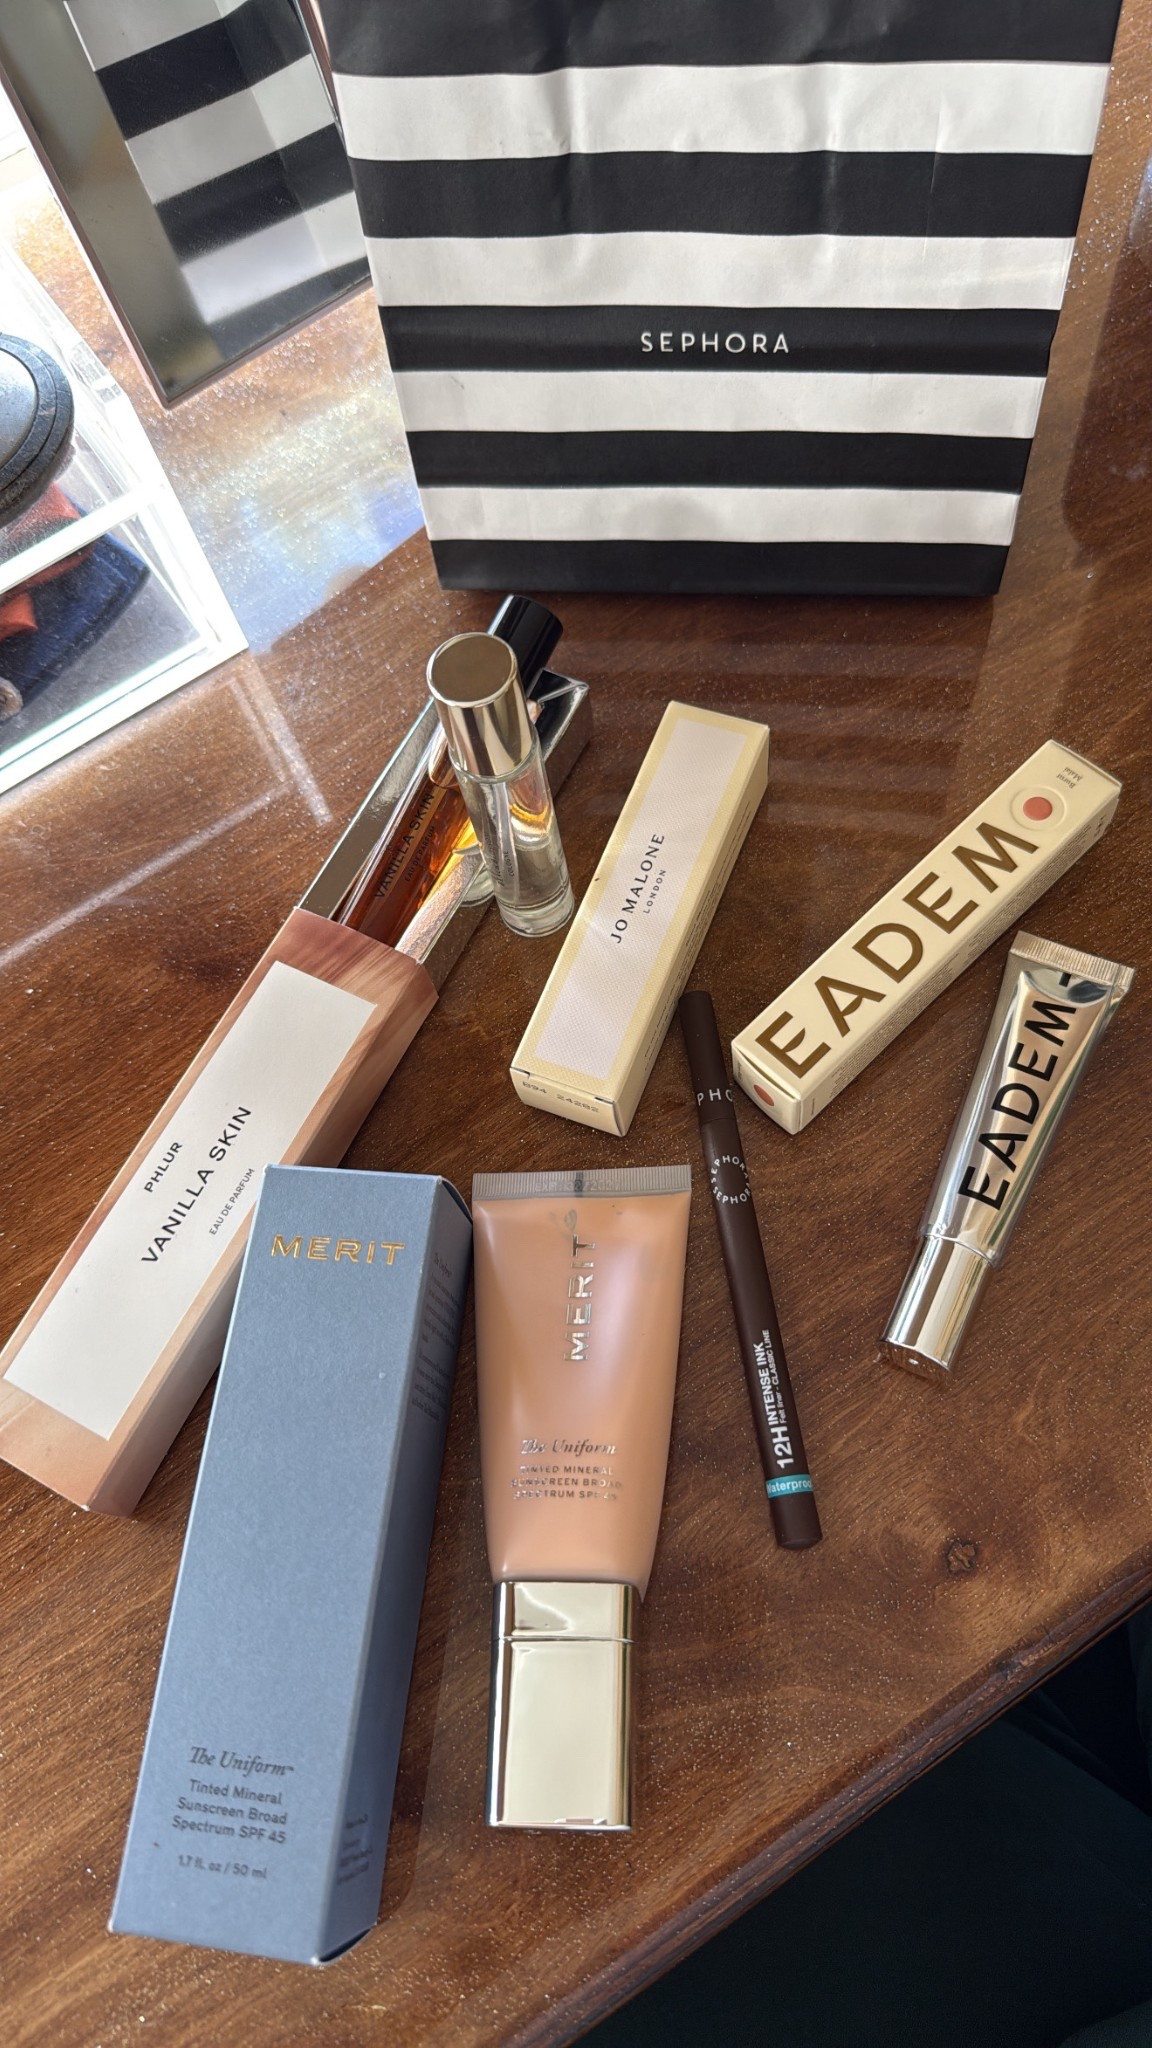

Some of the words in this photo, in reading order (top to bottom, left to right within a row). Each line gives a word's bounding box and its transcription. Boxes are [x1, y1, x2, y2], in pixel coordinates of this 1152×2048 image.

[640, 332, 790, 354] SEPHORA
[375, 835, 414, 899] VANILLA
[410, 793, 435, 831] SKIN
[610, 919, 628, 944] JO
[621, 834, 665, 914] MALONE
[643, 869, 667, 914] LONDON
[755, 821, 1040, 1079] EADEM
[958, 1000, 1077, 1211] EADEM
[144, 1142, 183, 1193] PHLUR
[141, 1168, 215, 1262] VANILLA
[209, 1106, 252, 1162] SKIN
[209, 1216, 224, 1235] EAU
[222, 1204, 233, 1217] DE
[231, 1168, 255, 1203] PARFUM
[271, 1233, 406, 1266] MERIT
[564, 1233, 595, 1361] MERIT
[753, 1341, 768, 1366] INK
[762, 1329, 771, 1349] LINE
[766, 1350, 780, 1385] CLASSIC
[758, 1367, 779, 1426] INTENSE
[777, 1392, 785, 1409] liner
[779, 1410, 787, 1424] Felt
[521, 1440, 546, 1454] The
[552, 1438, 617, 1457] Uniform
[770, 1425, 795, 1469] 12H
[511, 1478, 578, 1488] SUNSCREEN
[582, 1478, 623, 1488] BROAD
[520, 1465, 560, 1475] TINTED
[563, 1465, 613, 1476] MINERAL
[514, 1490, 575, 1500] SPECTRUM
[189, 1746, 216, 1766] The
[190, 1778, 230, 1797] Tinted
[233, 1785, 283, 1805] Mineral
[177, 1796, 244, 1818] Sunscreen
[248, 1807, 288, 1825] Broad
[172, 1815, 235, 1836] Spectrum
[239, 1825, 266, 1840] SPF
[268, 1830, 287, 1844] 45
[208, 1861, 222, 1872] oz
[233, 1863, 248, 1876] 50
[252, 1867, 267, 1880] ml
